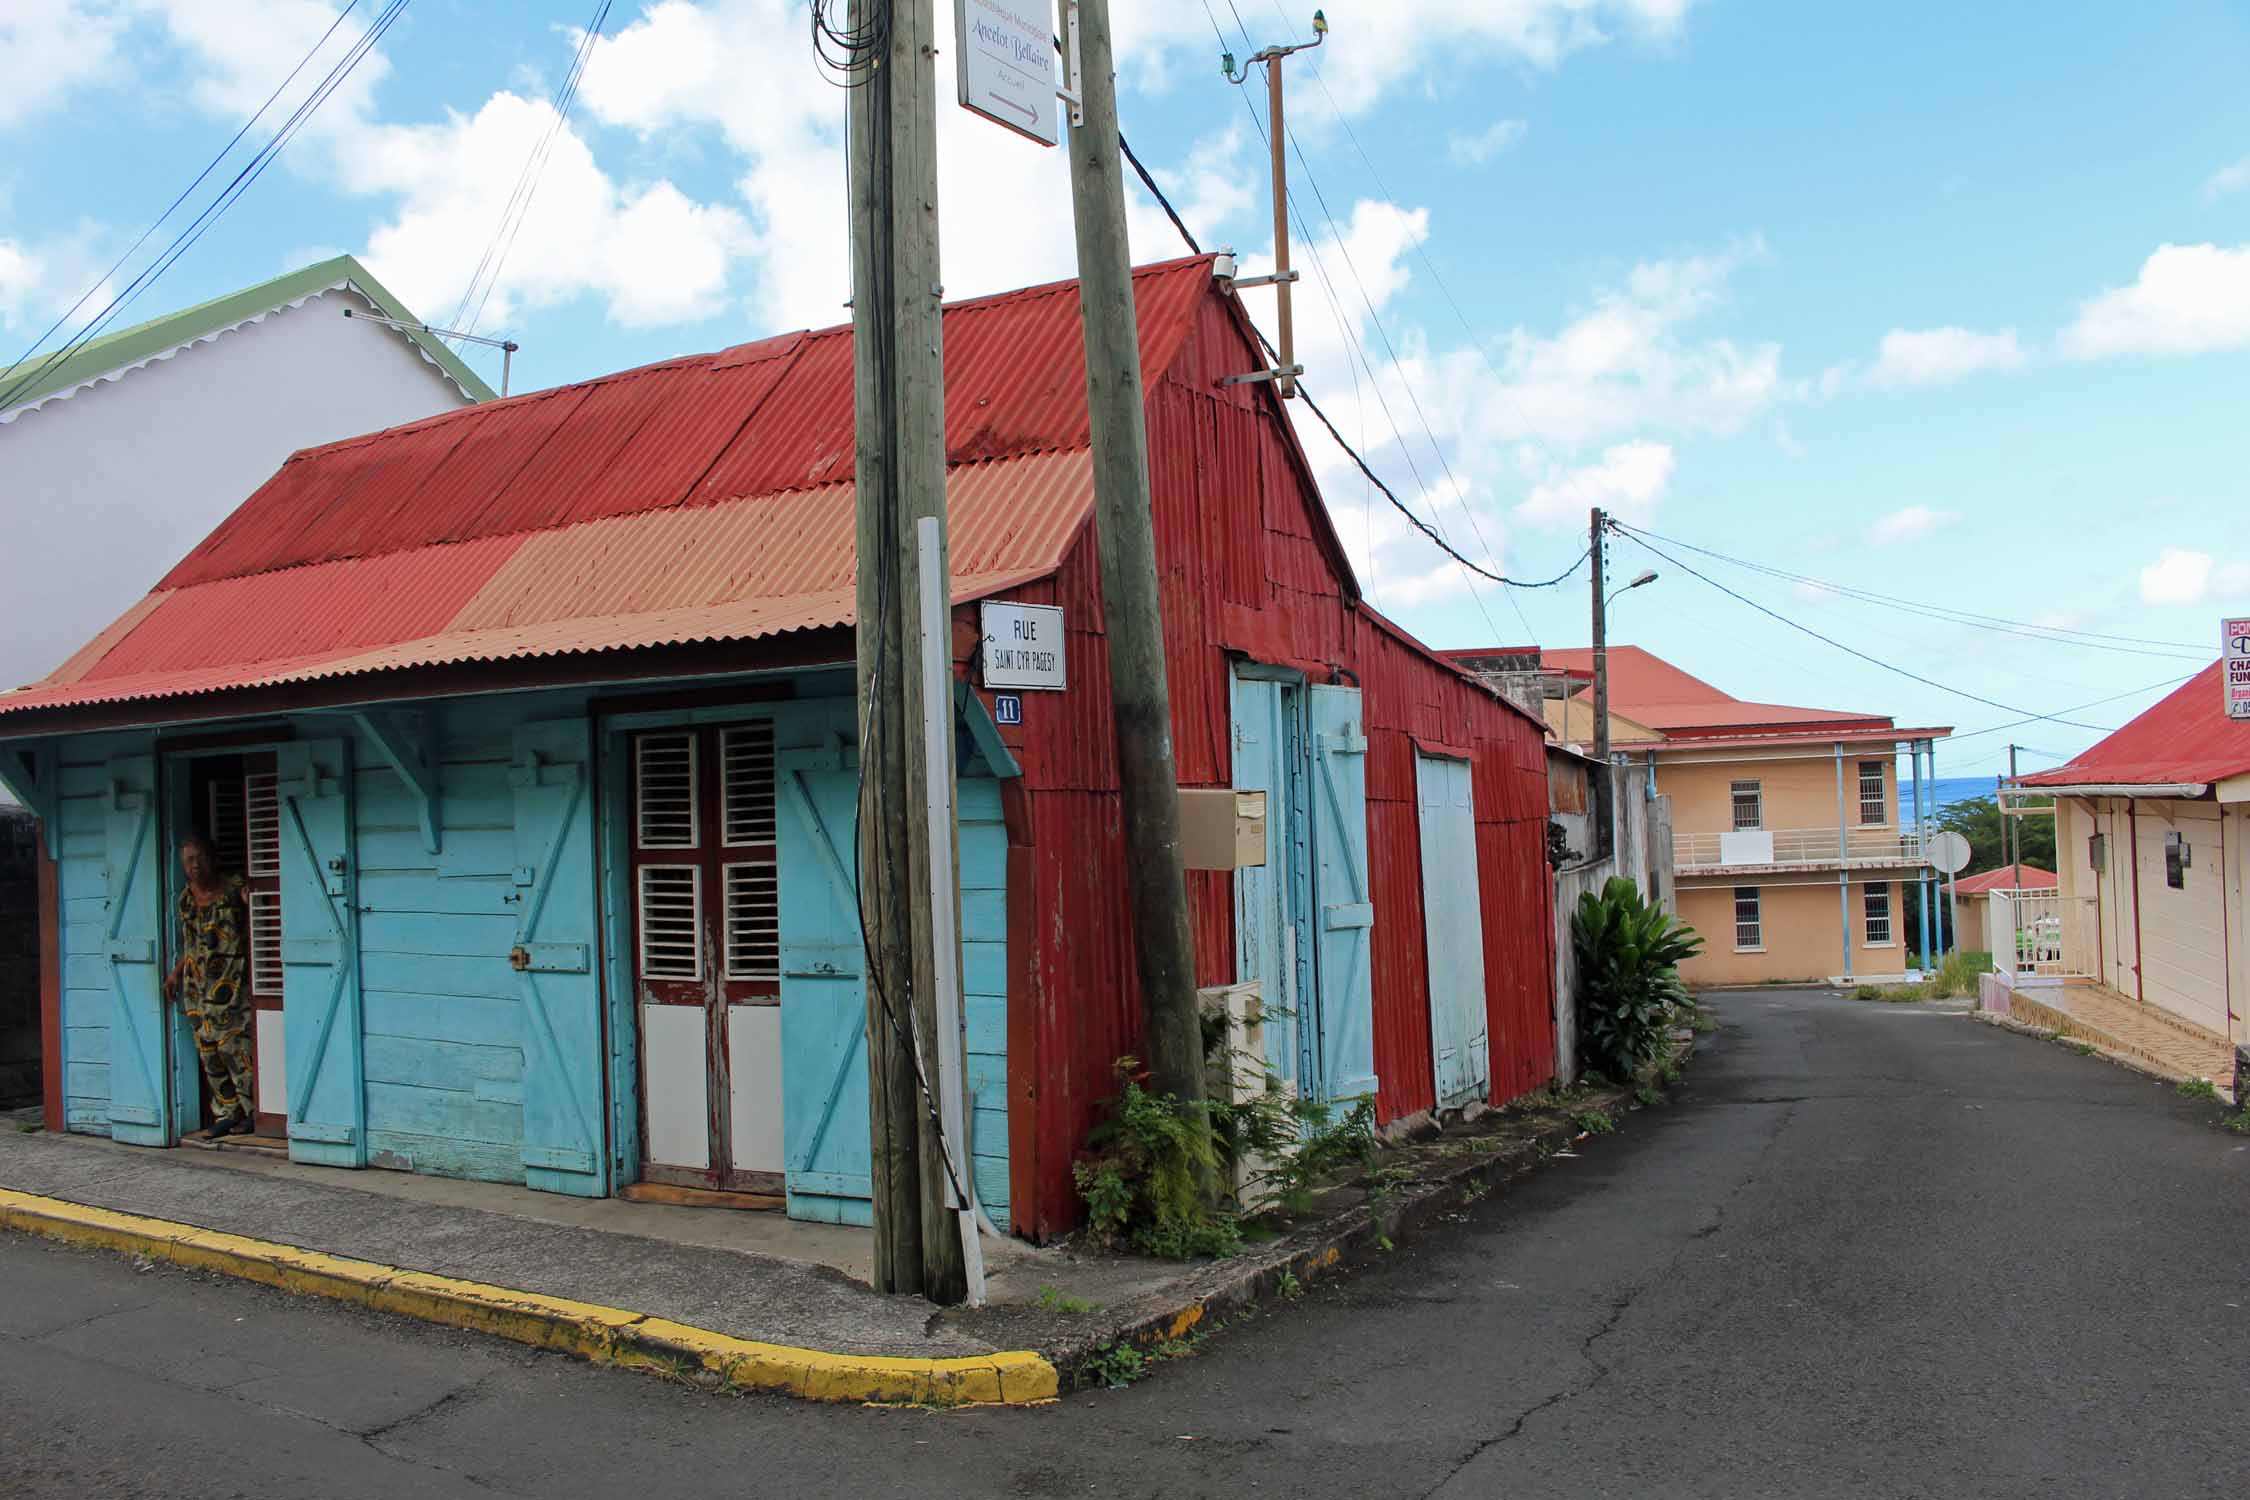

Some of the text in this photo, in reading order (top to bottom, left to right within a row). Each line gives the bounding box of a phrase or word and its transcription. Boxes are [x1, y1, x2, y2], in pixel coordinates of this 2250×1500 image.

[972, 16, 1049, 71] Ancelot Bellaire
[1014, 619, 1037, 641] RUE
[995, 648, 1014, 670] SAINT
[1017, 650, 1030, 670] CYR
[1002, 699, 1015, 720] 11
